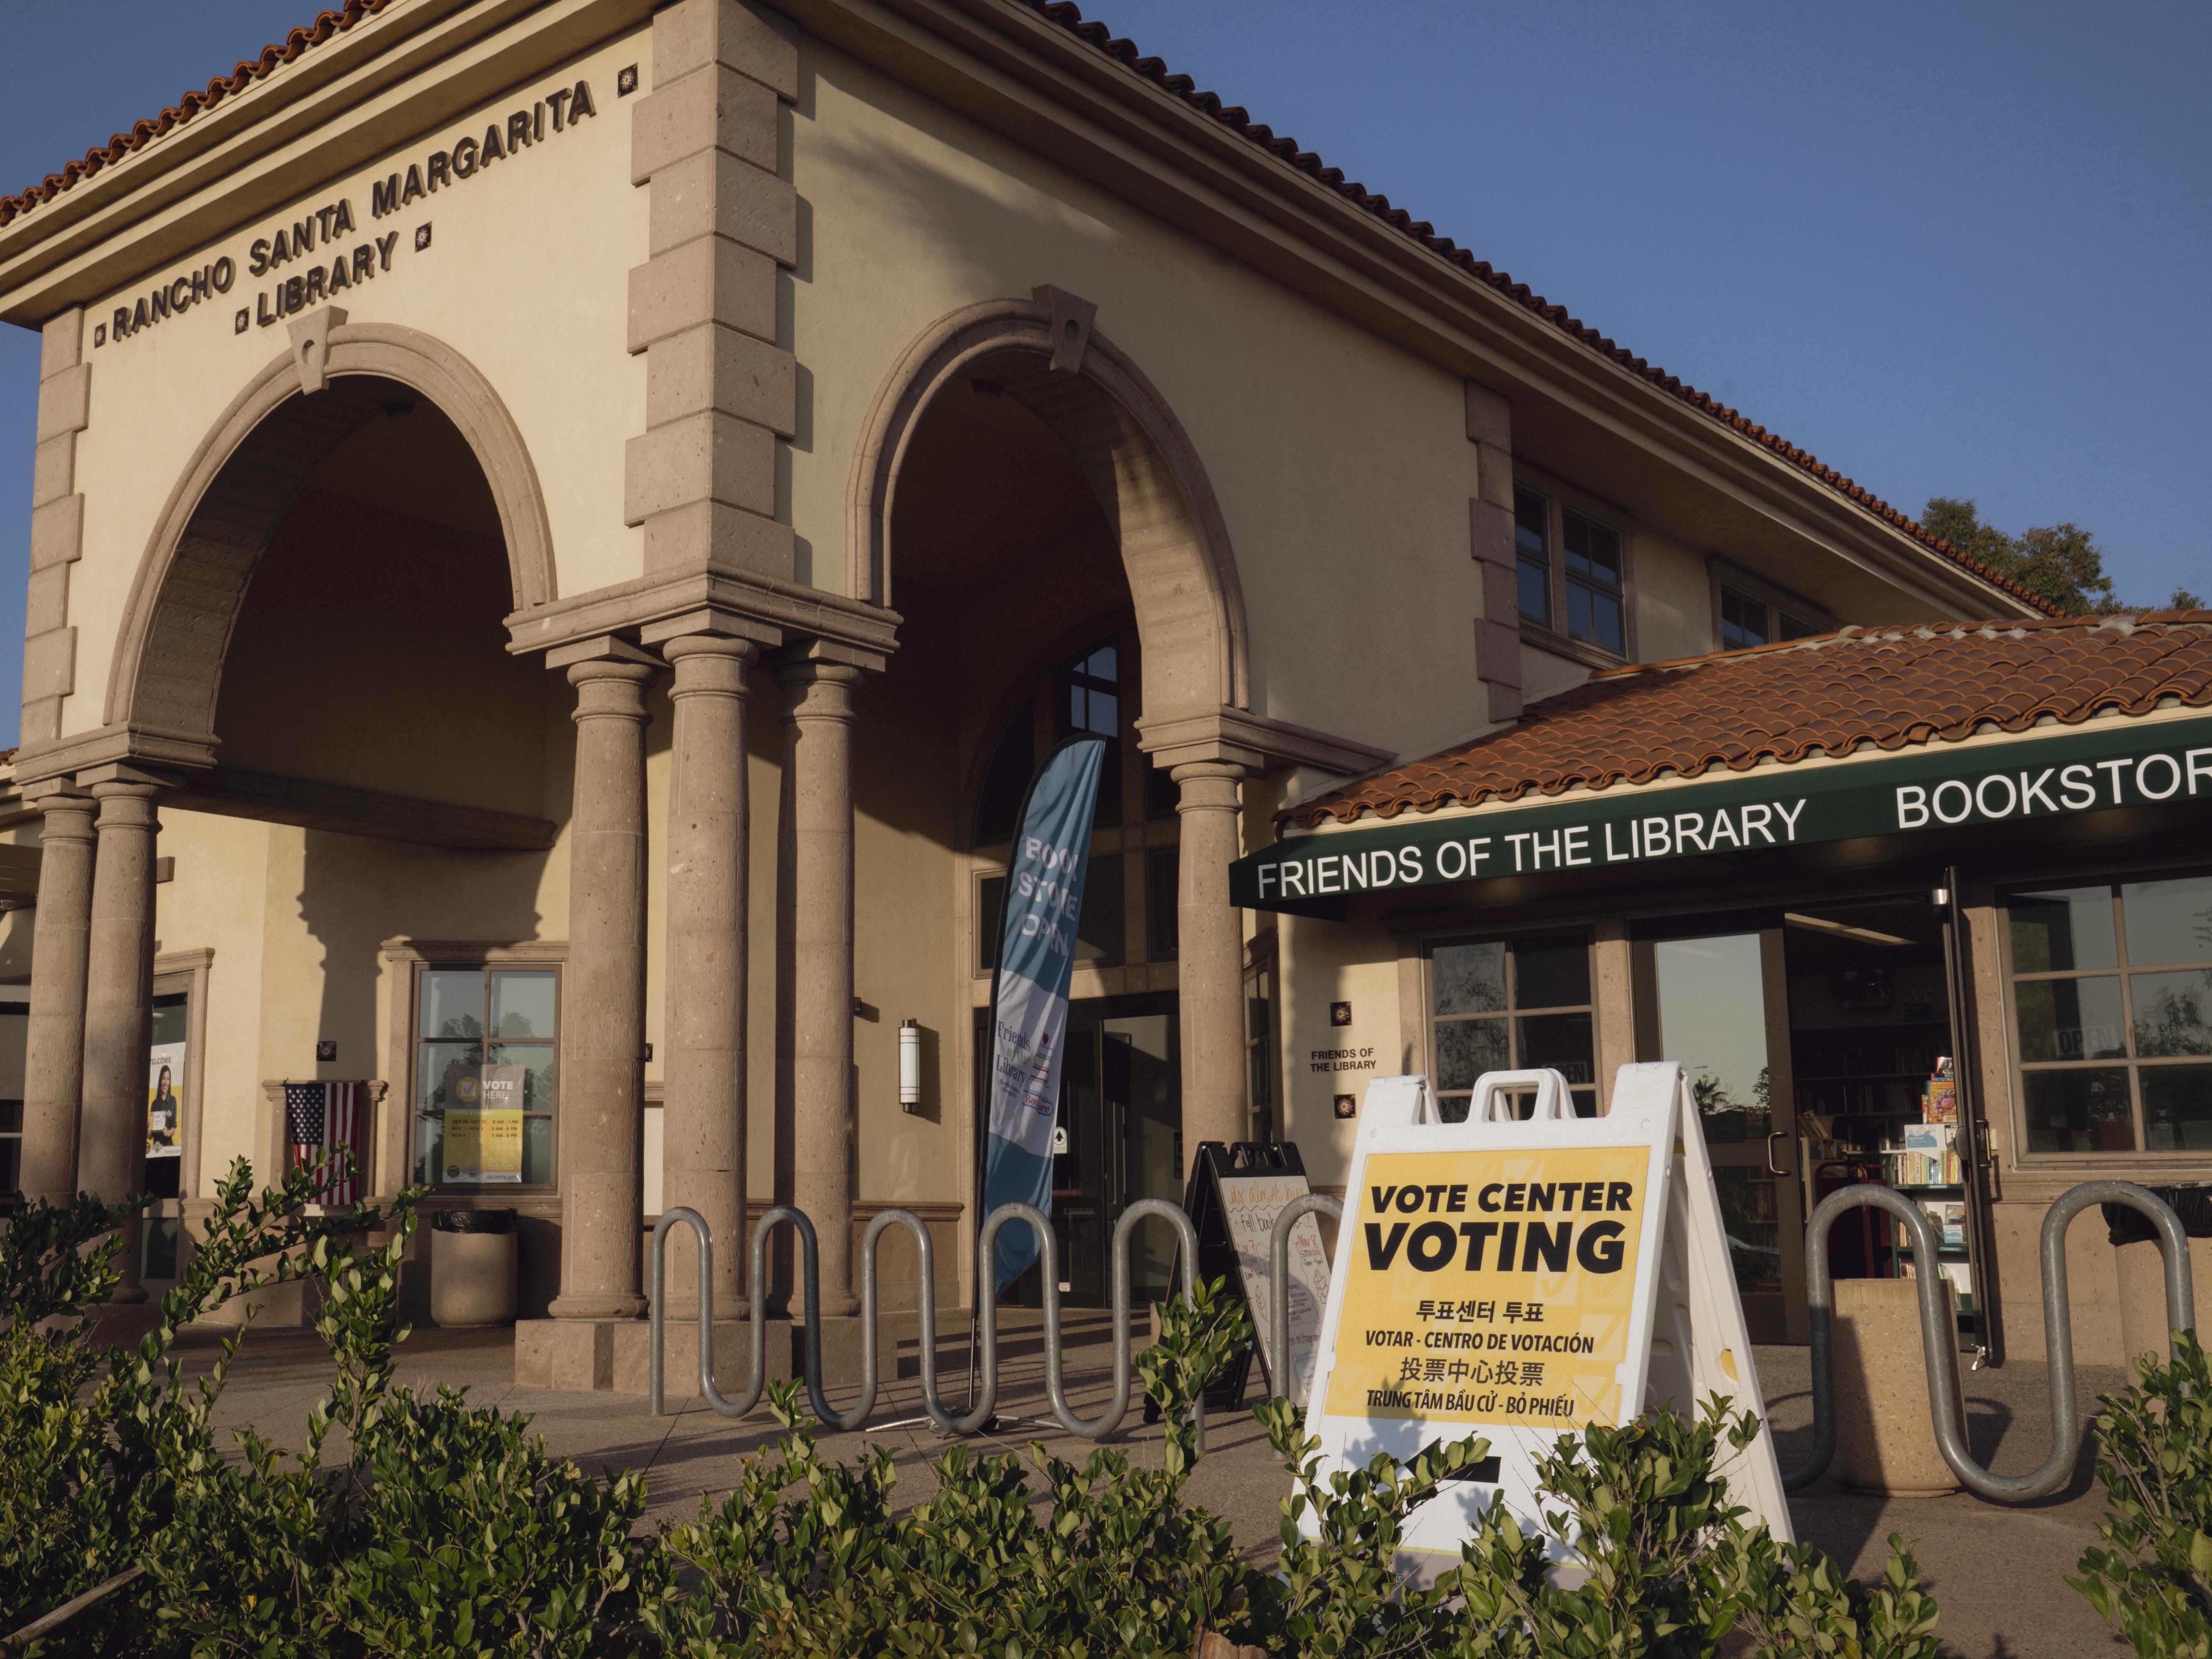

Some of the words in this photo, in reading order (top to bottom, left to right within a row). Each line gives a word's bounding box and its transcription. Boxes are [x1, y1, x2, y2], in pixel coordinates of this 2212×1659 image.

[112, 256, 236, 342] RANCHO
[249, 198, 356, 276] SANTA
[372, 80, 597, 219] MARGARITA
[257, 231, 399, 327] LIBRARY
[1258, 846, 1423, 899] FRIENDS
[1436, 837, 1491, 878] OF
[1504, 826, 1591, 871] THE
[1606, 799, 1807, 862] LIBRARY
[998, 1021, 1030, 1051] Friends
[2058, 1027, 2117, 1054] OPEN
[150, 1057, 172, 1065] ELCOME
[1007, 1046, 1018, 1063] of
[1017, 1049, 1030, 1066] the
[1310, 1063, 1330, 1072] THE
[1334, 1060, 1376, 1071] LIBRARY
[1312, 1049, 1356, 1060] FRIENDS
[1360, 1048, 1374, 1057] OF
[996, 1054, 1026, 1087] Library
[1546, 1063, 1585, 1084] PEN
[482, 1080, 513, 1090] VOTE
[1229, 1184, 1245, 1205] it's
[1249, 1180, 1283, 1203] almost
[1371, 1185, 1468, 1214] VOTE
[1478, 1182, 1633, 1212] CENTER
[1241, 1213, 1257, 1233] fall
[1255, 1212, 1275, 1232] book
[1248, 1239, 1256, 1255] 7
[1297, 1234, 1310, 1249] Nov
[1310, 1234, 1318, 1248] 8
[1364, 1220, 1626, 1274] VOTING
[1416, 1300, 1496, 1323] 투표센터
[1502, 1301, 1544, 1324] 투표
[1365, 1330, 1414, 1347] VOTAR
[1424, 1331, 1483, 1350] CENTRO
[1487, 1334, 1507, 1350] DE
[1511, 1332, 1594, 1353] VOTACIÓN
[1399, 1356, 1545, 1387] 投票中心投票
[1367, 1389, 1412, 1408] TRUNG
[1414, 1389, 1443, 1410] TÂM
[1445, 1389, 1475, 1411] BẦU
[1477, 1390, 1498, 1412] CỬ
[1506, 1391, 1527, 1414] BỎ
[1529, 1394, 1574, 1417] PHIẾU
